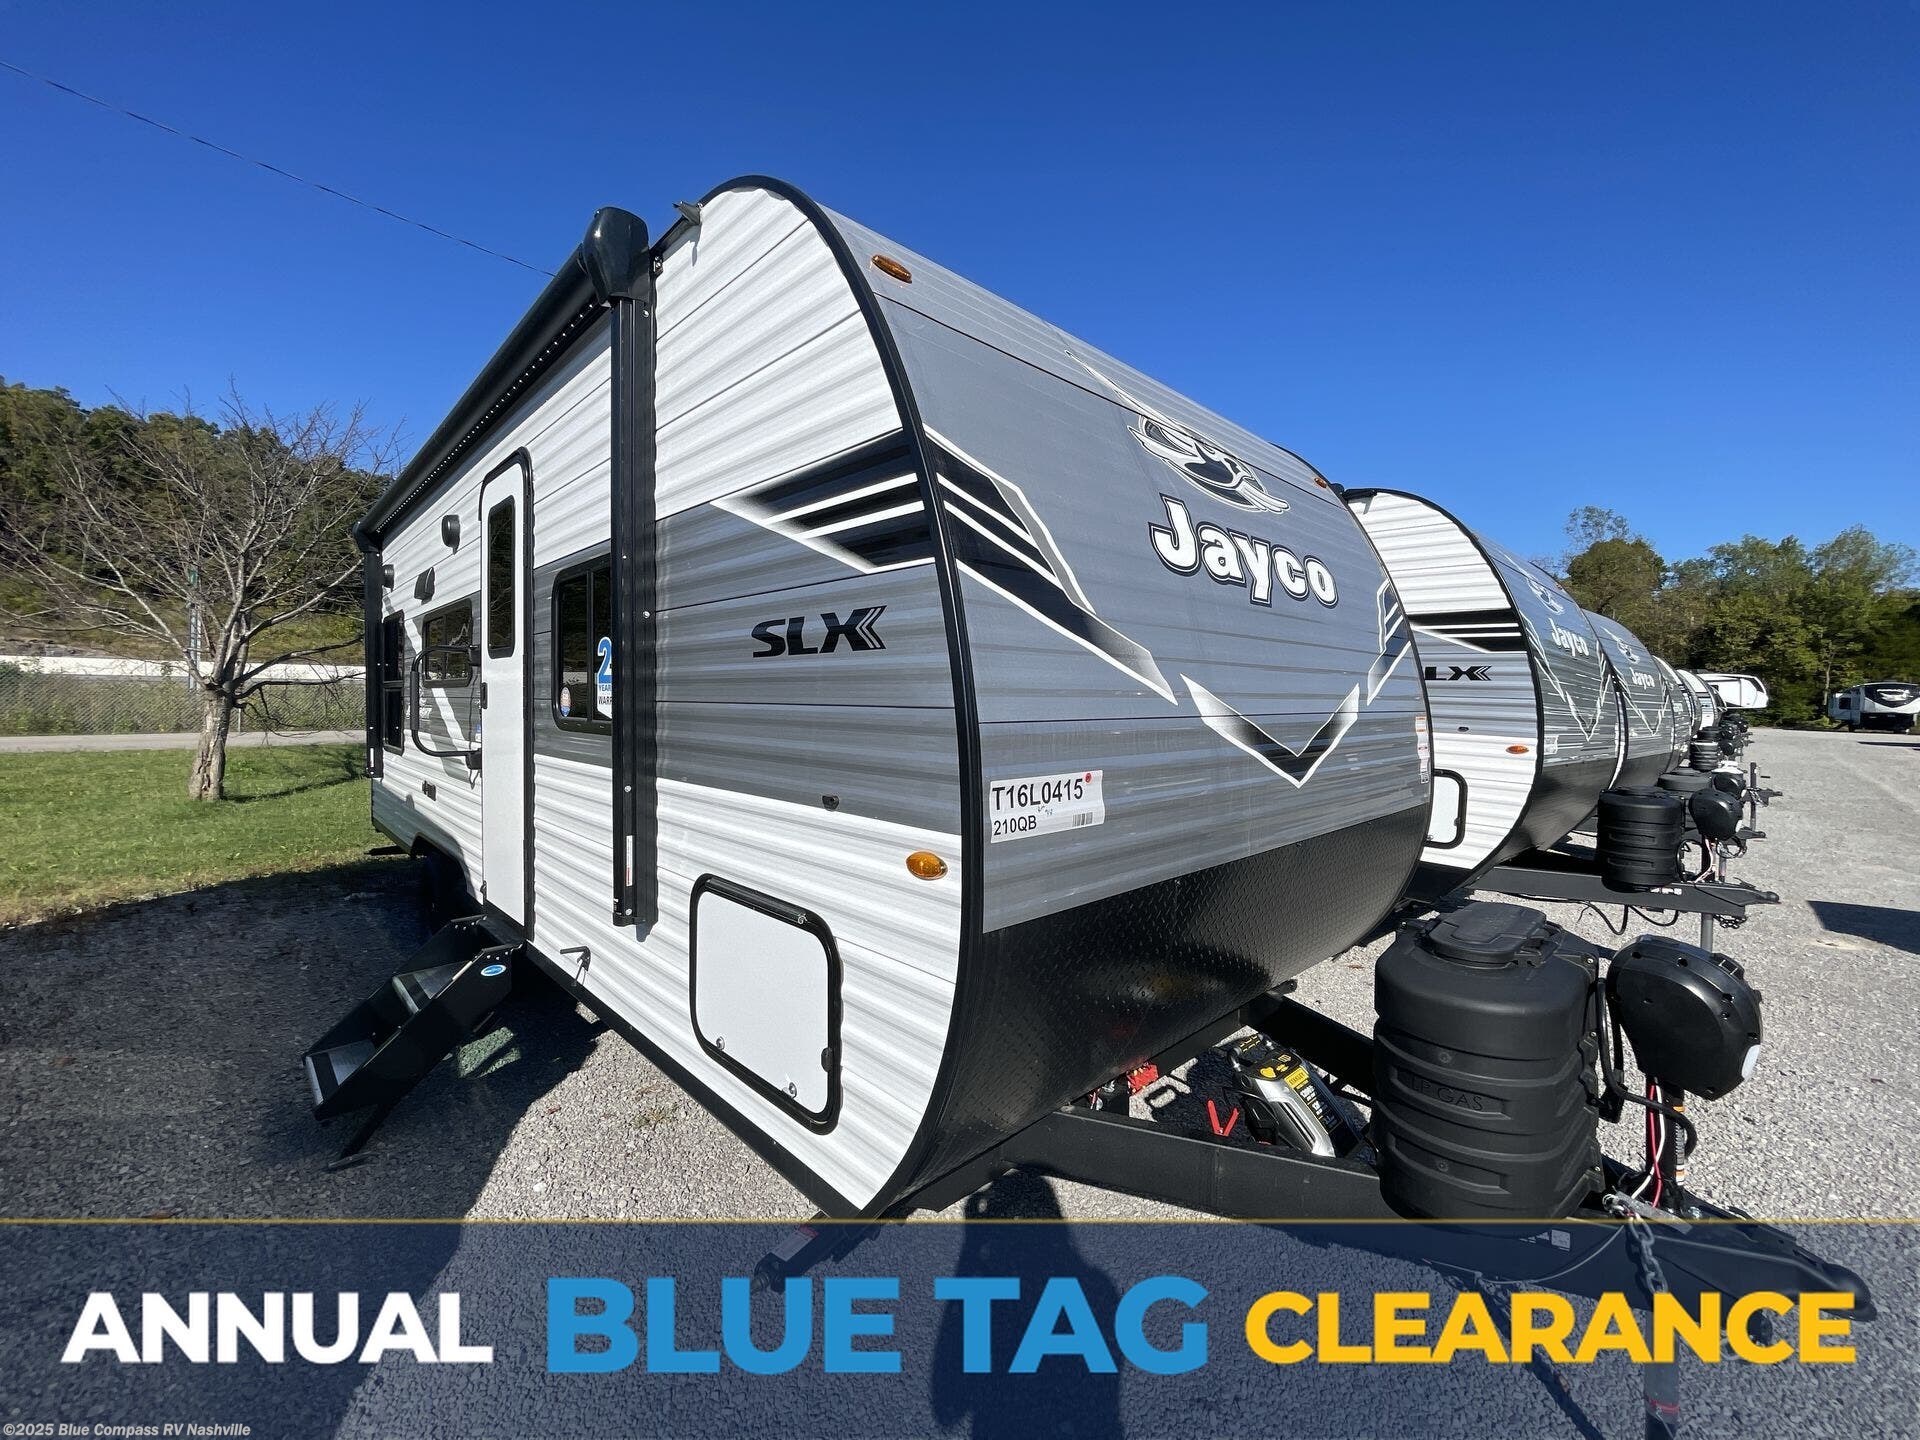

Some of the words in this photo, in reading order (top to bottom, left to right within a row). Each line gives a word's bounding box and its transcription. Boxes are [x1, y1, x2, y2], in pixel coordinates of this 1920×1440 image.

[1149, 493, 1339, 609] Jayco
[751, 605, 887, 658] SLX
[1548, 618, 1590, 657] Jayco
[992, 778, 1084, 811] T16L0415
[993, 815, 1037, 836] 210QB
[1437, 1087, 1484, 1112] GAS
